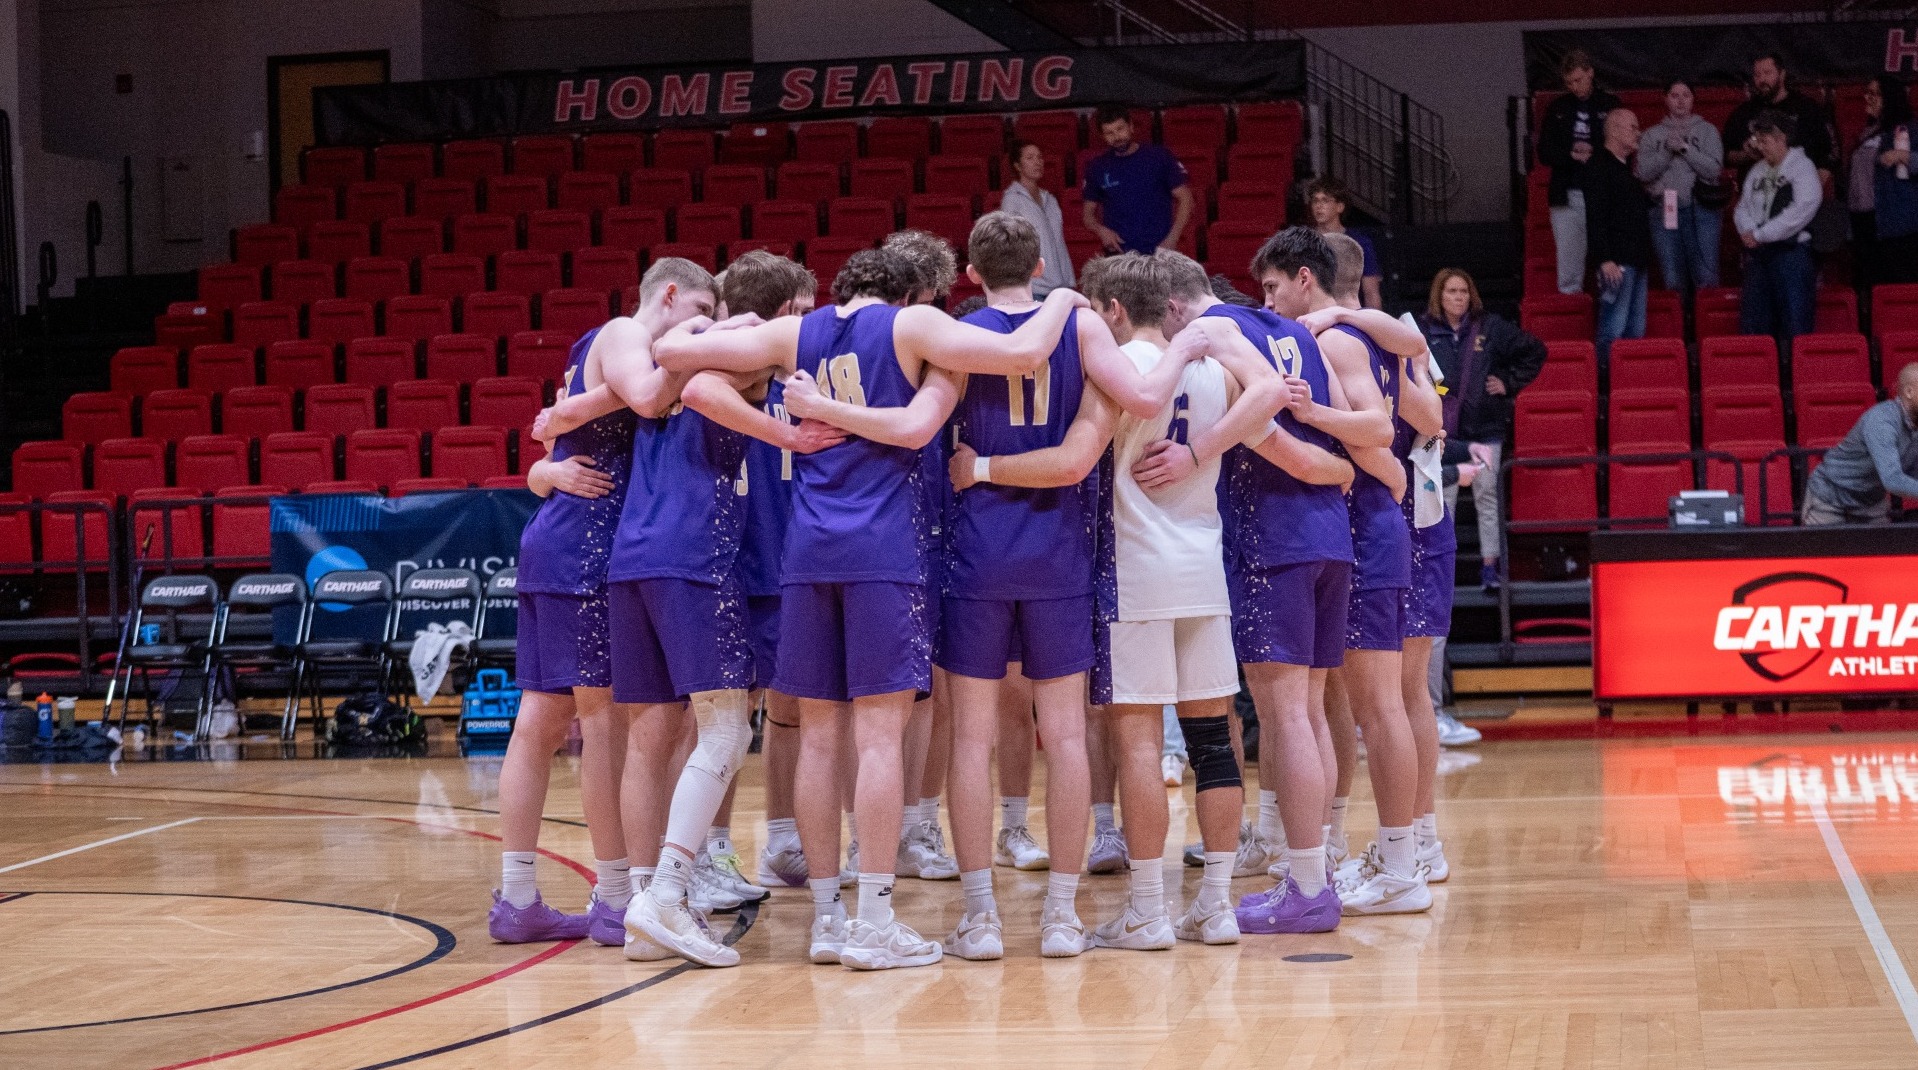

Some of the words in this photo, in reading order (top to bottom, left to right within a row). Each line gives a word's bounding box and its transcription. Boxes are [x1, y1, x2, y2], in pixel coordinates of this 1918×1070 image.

[554, 71, 754, 122] HOME
[778, 56, 1075, 112] SEATING
[237, 582, 296, 596] CARTHAGE
[323, 580, 383, 593] CARTHAGE
[411, 577, 470, 590] CARTHAGE
[151, 585, 208, 598] CARTHAGE
[1713, 603, 1918, 651] CARTHA
[466, 719, 511, 729] POWERADE
